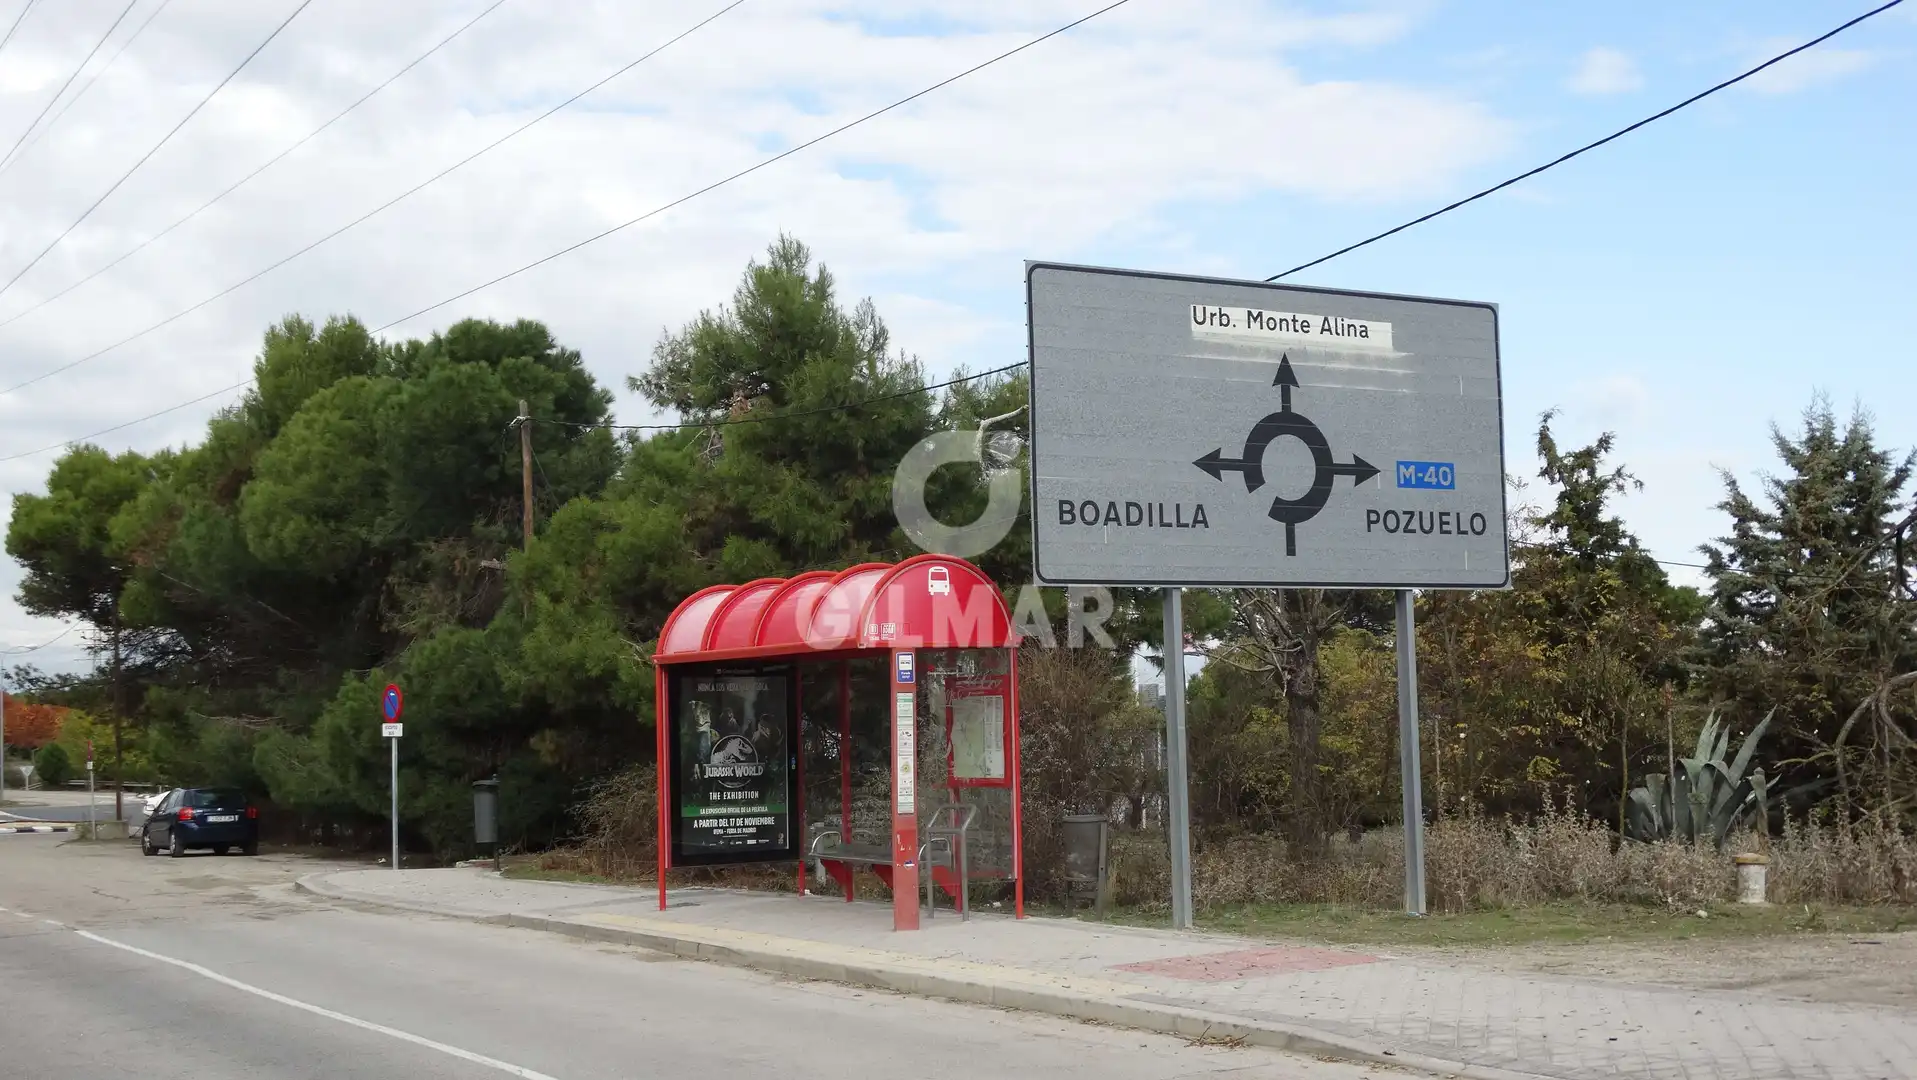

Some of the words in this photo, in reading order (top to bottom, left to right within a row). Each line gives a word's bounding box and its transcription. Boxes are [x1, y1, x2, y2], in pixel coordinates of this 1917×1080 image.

[1192, 305, 1236, 328] Urb.
[1247, 309, 1311, 334] Monte
[1319, 316, 1370, 339] Alina
[1398, 464, 1452, 486] M-40
[1058, 499, 1210, 529] BOADILLA
[1366, 509, 1487, 536] POZUELO
[703, 766, 734, 778] JURASSIC
[734, 765, 764, 778] WORLD
[709, 791, 721, 800] THE
[723, 790, 759, 800] EXHIBITION
[693, 820, 699, 828] A
[699, 819, 718, 828] PARTIR
[719, 818, 729, 827] DEL
[729, 818, 735, 827] 17
[736, 818, 744, 826] DE
[744, 816, 775, 826] NOVIEMBRE
